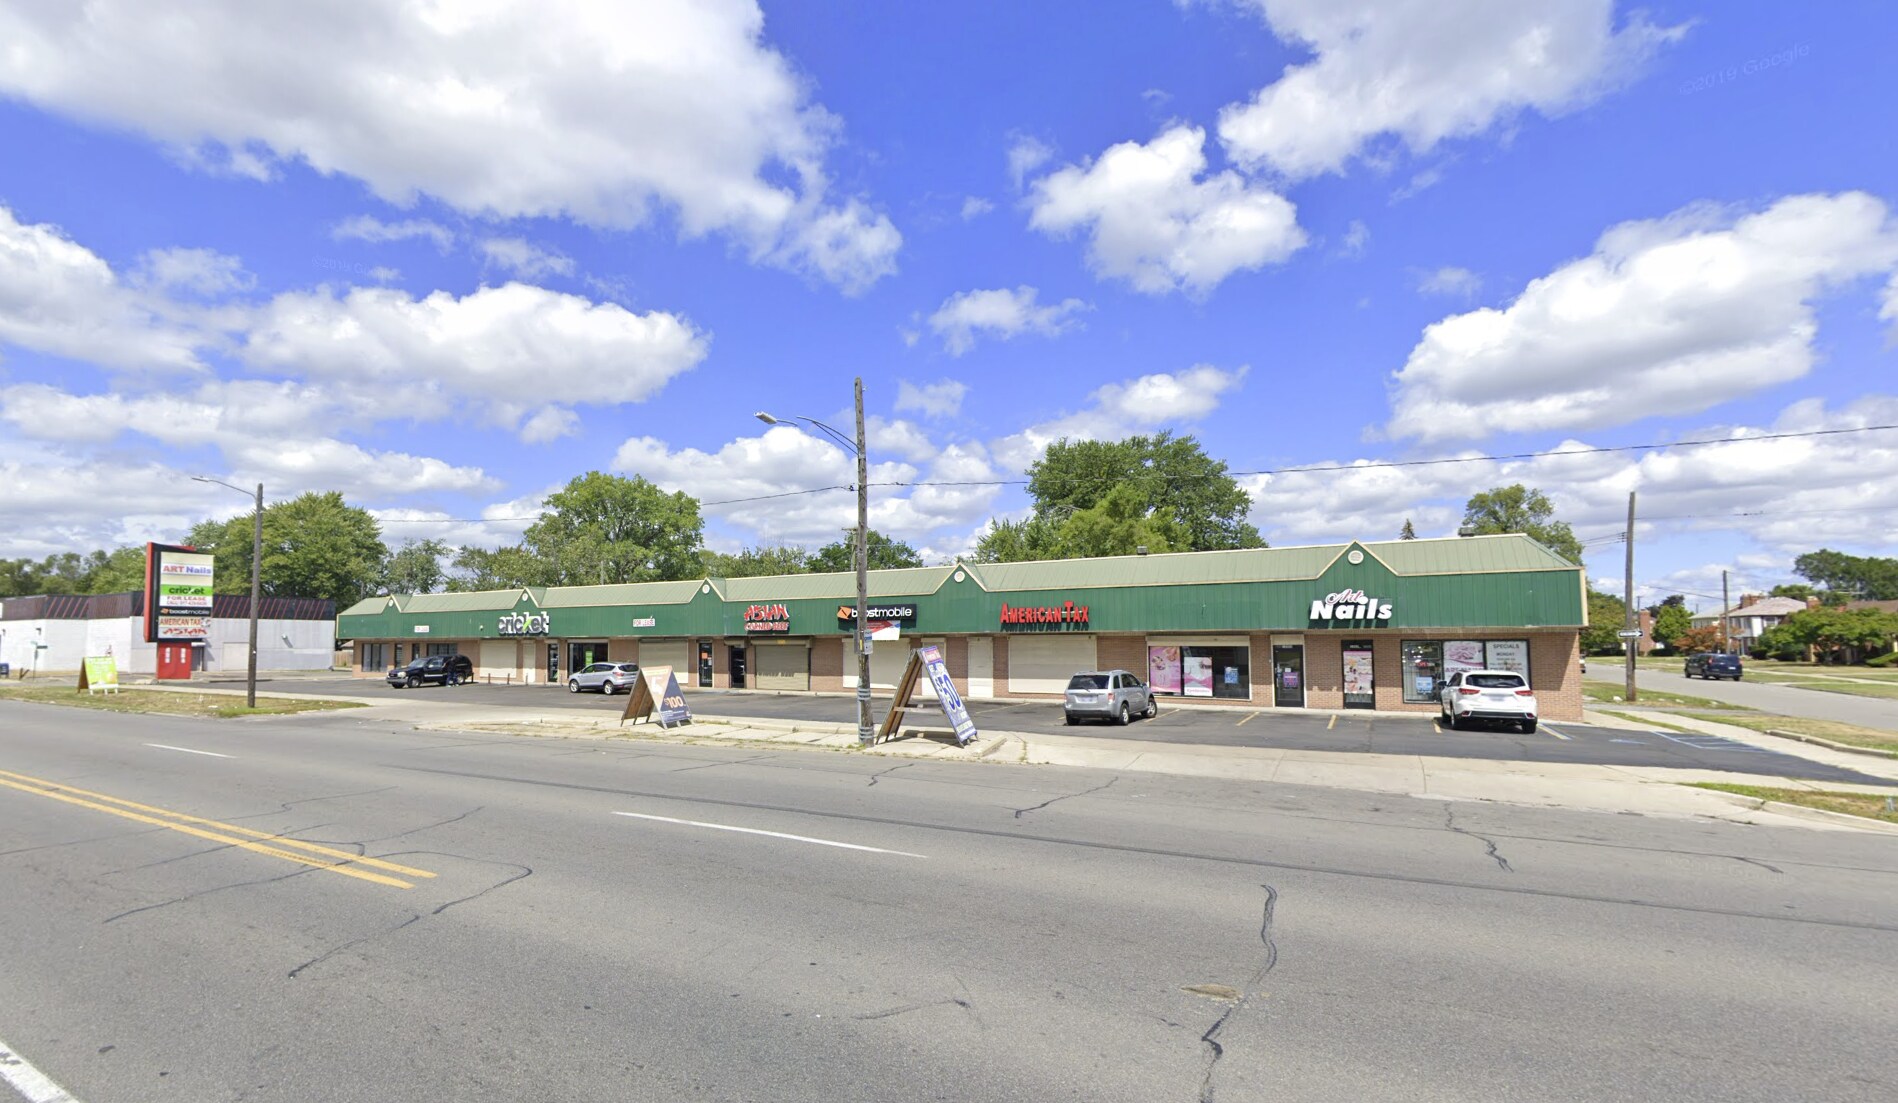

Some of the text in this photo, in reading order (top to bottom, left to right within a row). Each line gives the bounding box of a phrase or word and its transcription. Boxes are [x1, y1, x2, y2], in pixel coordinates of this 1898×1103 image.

[163, 565, 211, 574] ART Nails
[169, 586, 205, 595] cricket
[1325, 588, 1368, 605] Art
[744, 603, 790, 621] ASIAN
[1310, 598, 1392, 620] Nails
[498, 611, 549, 634] cricket
[664, 696, 684, 709] $100
